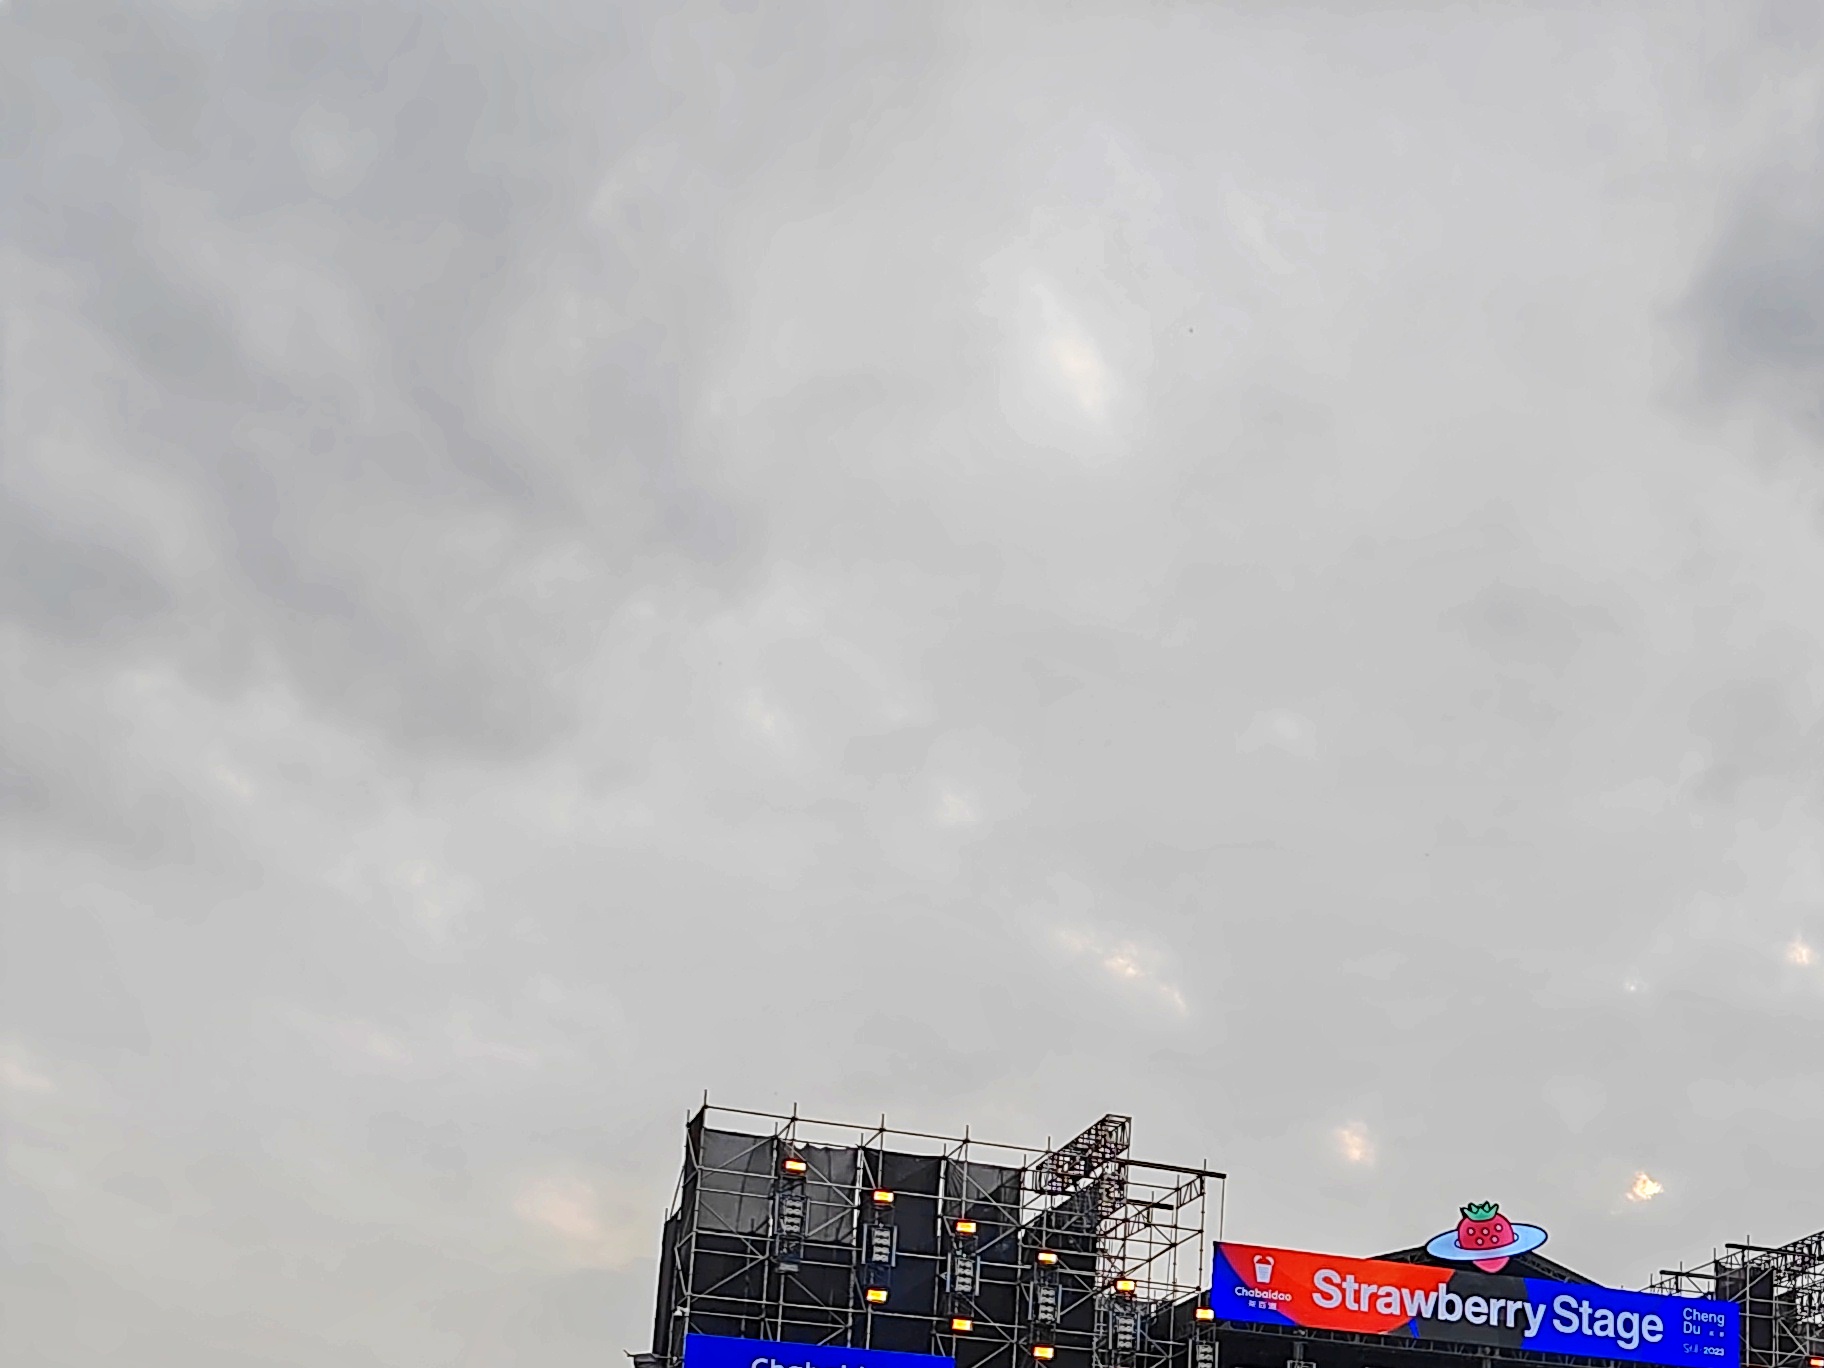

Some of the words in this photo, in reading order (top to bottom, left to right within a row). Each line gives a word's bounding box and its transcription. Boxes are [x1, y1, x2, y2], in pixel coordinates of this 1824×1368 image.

[1234, 1286, 1292, 1302] Chabaidao
[1312, 1268, 1546, 1338] Strawberry
[1552, 1294, 1664, 1350] Stage
[1682, 1307, 1725, 1327] Cheng
[1683, 1321, 1701, 1335] Du
[1703, 1346, 1725, 1356] 2023
